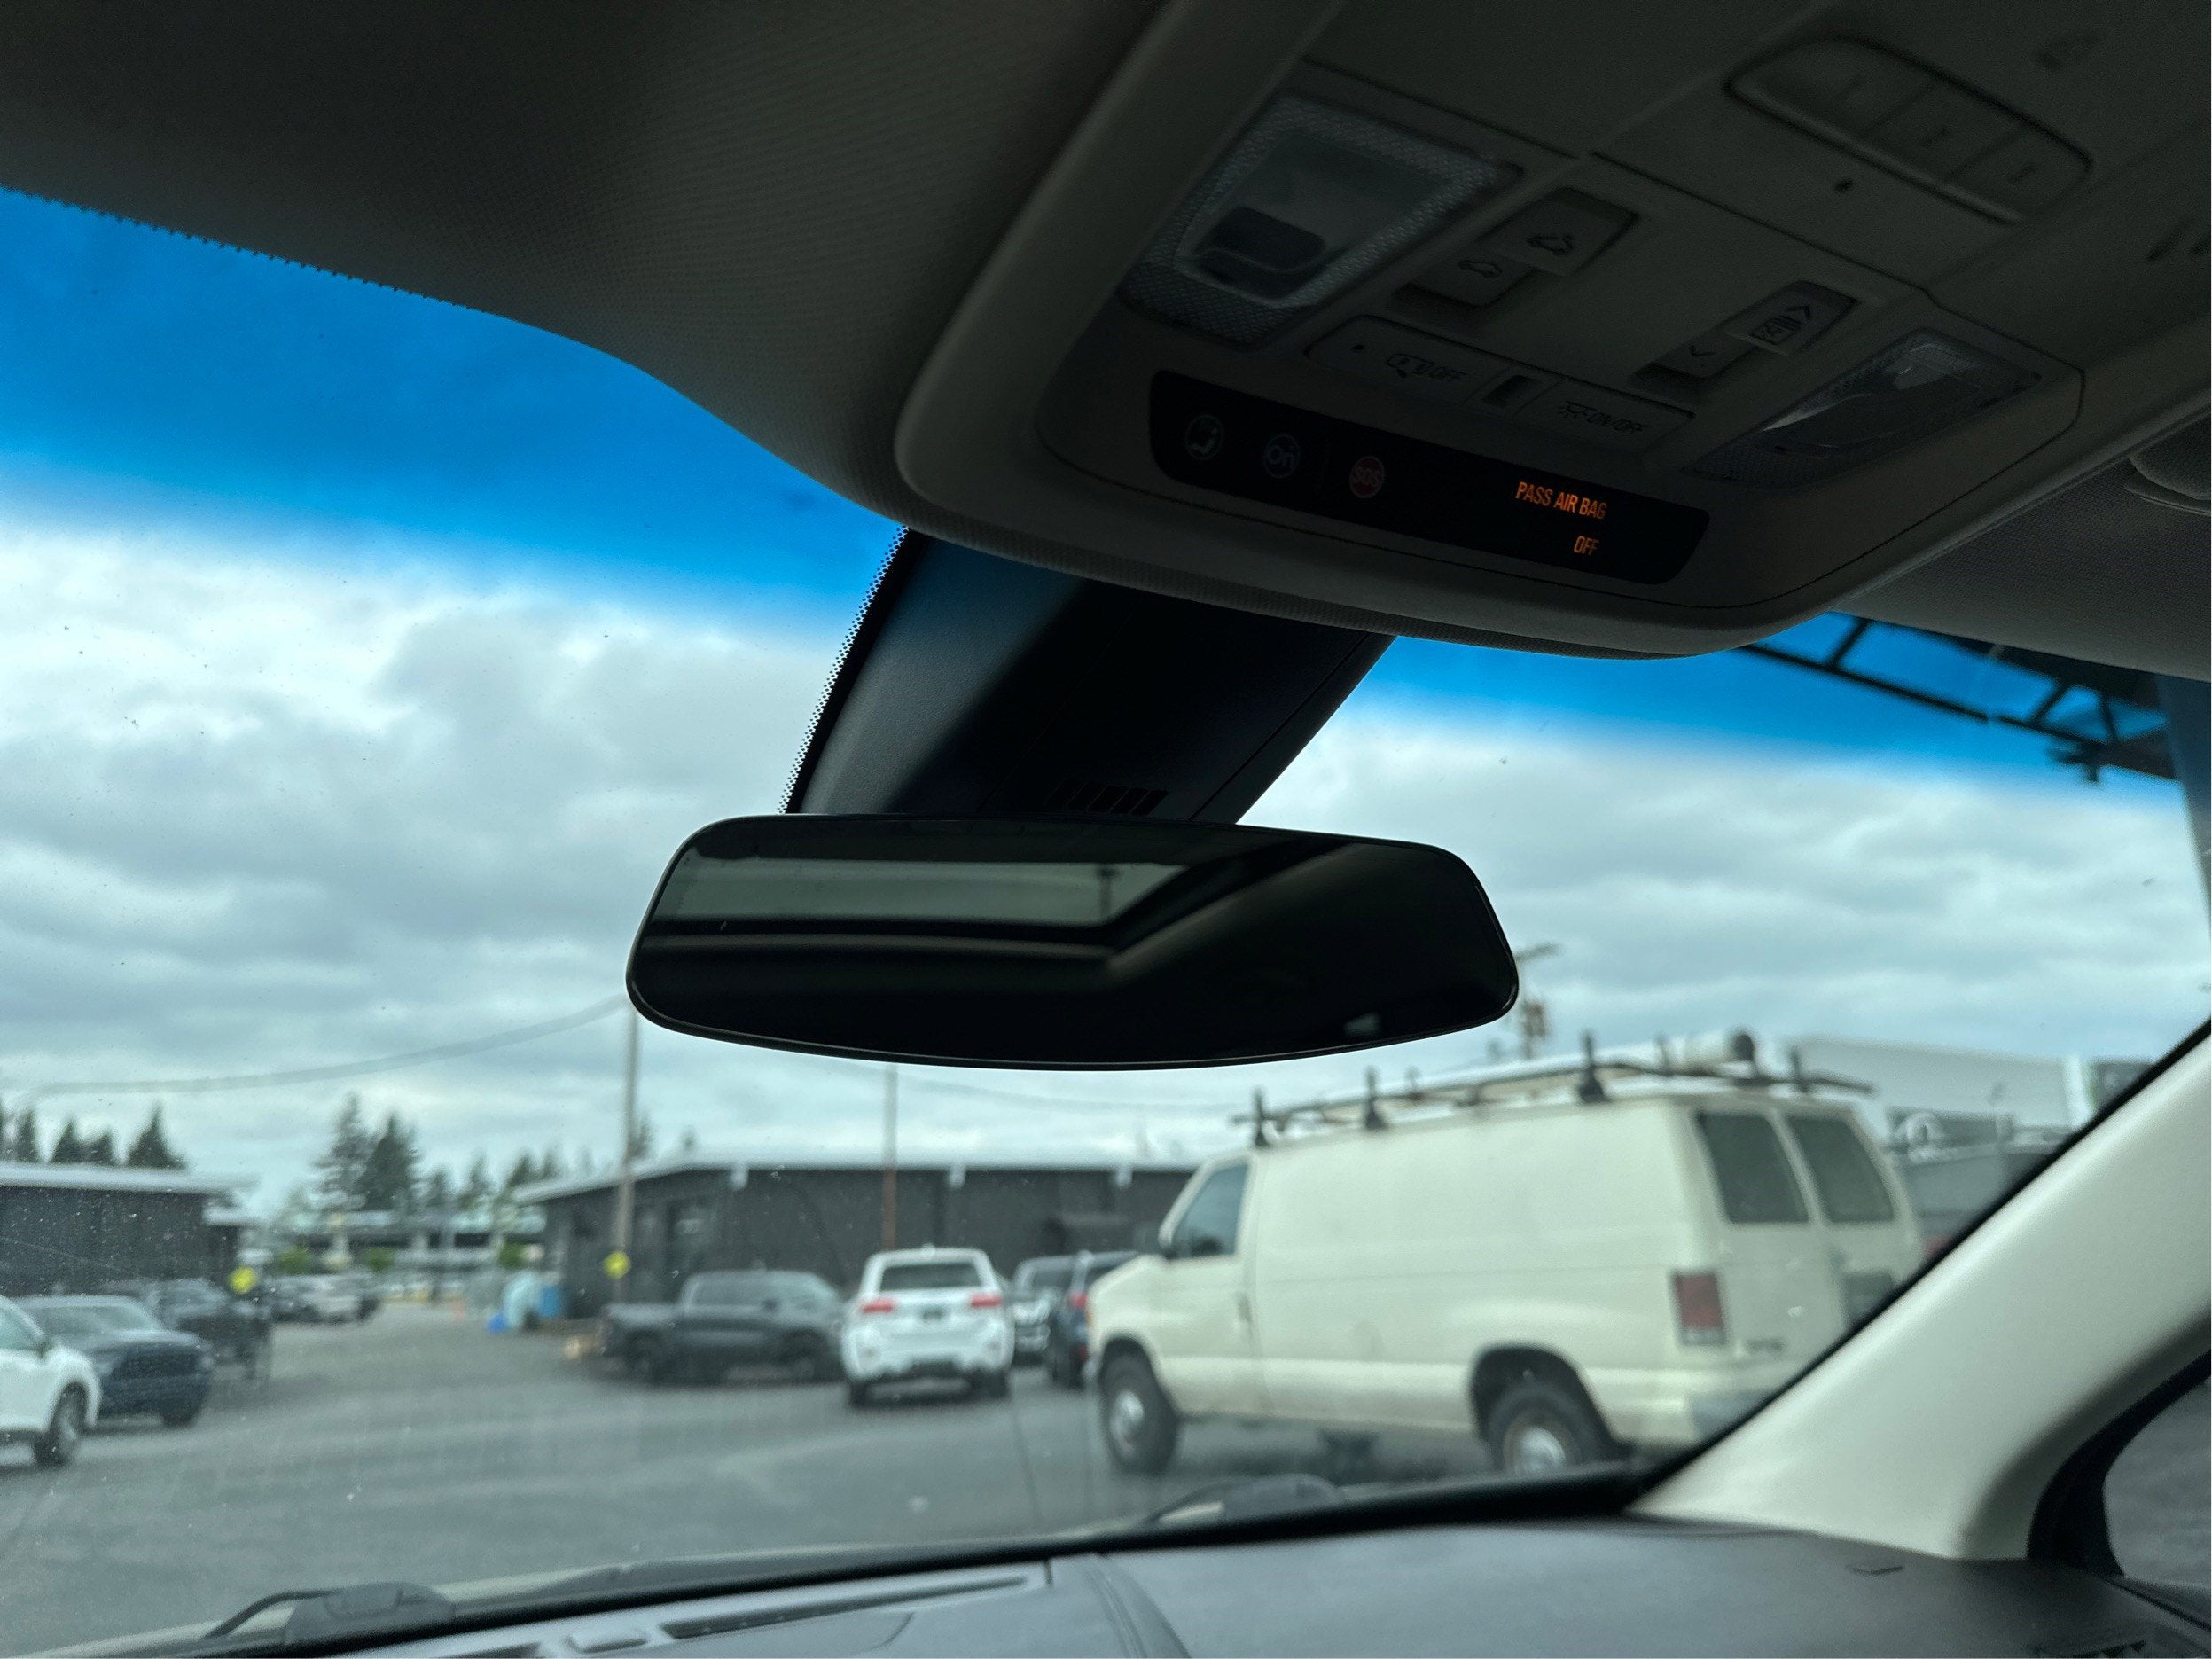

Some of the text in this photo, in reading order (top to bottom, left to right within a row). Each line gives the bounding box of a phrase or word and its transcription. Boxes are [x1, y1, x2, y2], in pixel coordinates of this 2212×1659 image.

[1353, 464, 1382, 485] SOS
[1514, 481, 1608, 520] PASS AIR BAG
[1573, 535, 1600, 556] OFF
